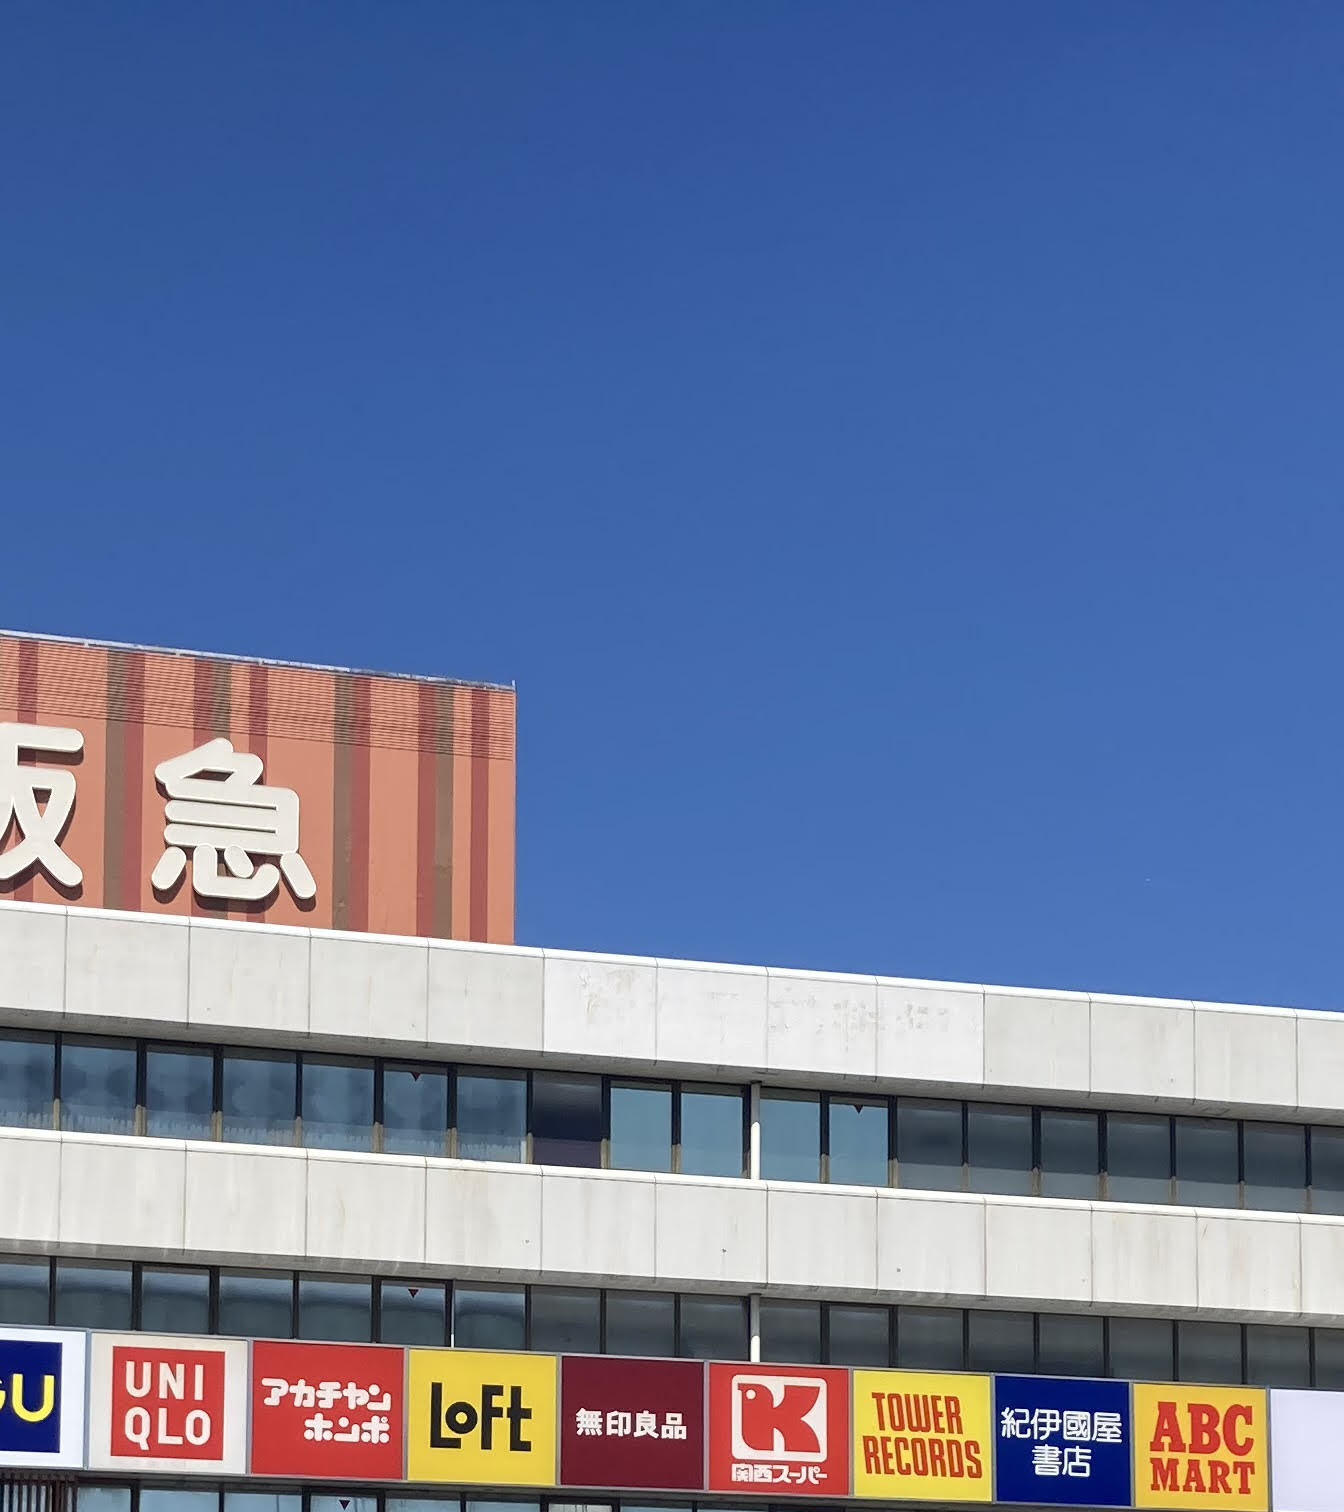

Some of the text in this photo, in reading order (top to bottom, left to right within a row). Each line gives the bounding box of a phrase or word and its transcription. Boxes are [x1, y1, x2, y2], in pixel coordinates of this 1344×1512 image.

[125, 1360, 204, 1402] UNI
[260, 1377, 392, 1412] アカチャン
[123, 1406, 212, 1452] QLO
[303, 1412, 390, 1445] ホンポ
[575, 1408, 688, 1440] 無印良品
[870, 1391, 963, 1435] TOWER
[1000, 1406, 1123, 1445] 紀伊國屋
[1149, 1400, 1255, 1457] ABC
[730, 1462, 828, 1486] 関西スーパー
[862, 1437, 984, 1480] RECORDS
[1031, 1444, 1092, 1479] 書店
[1150, 1455, 1256, 1496] MART
